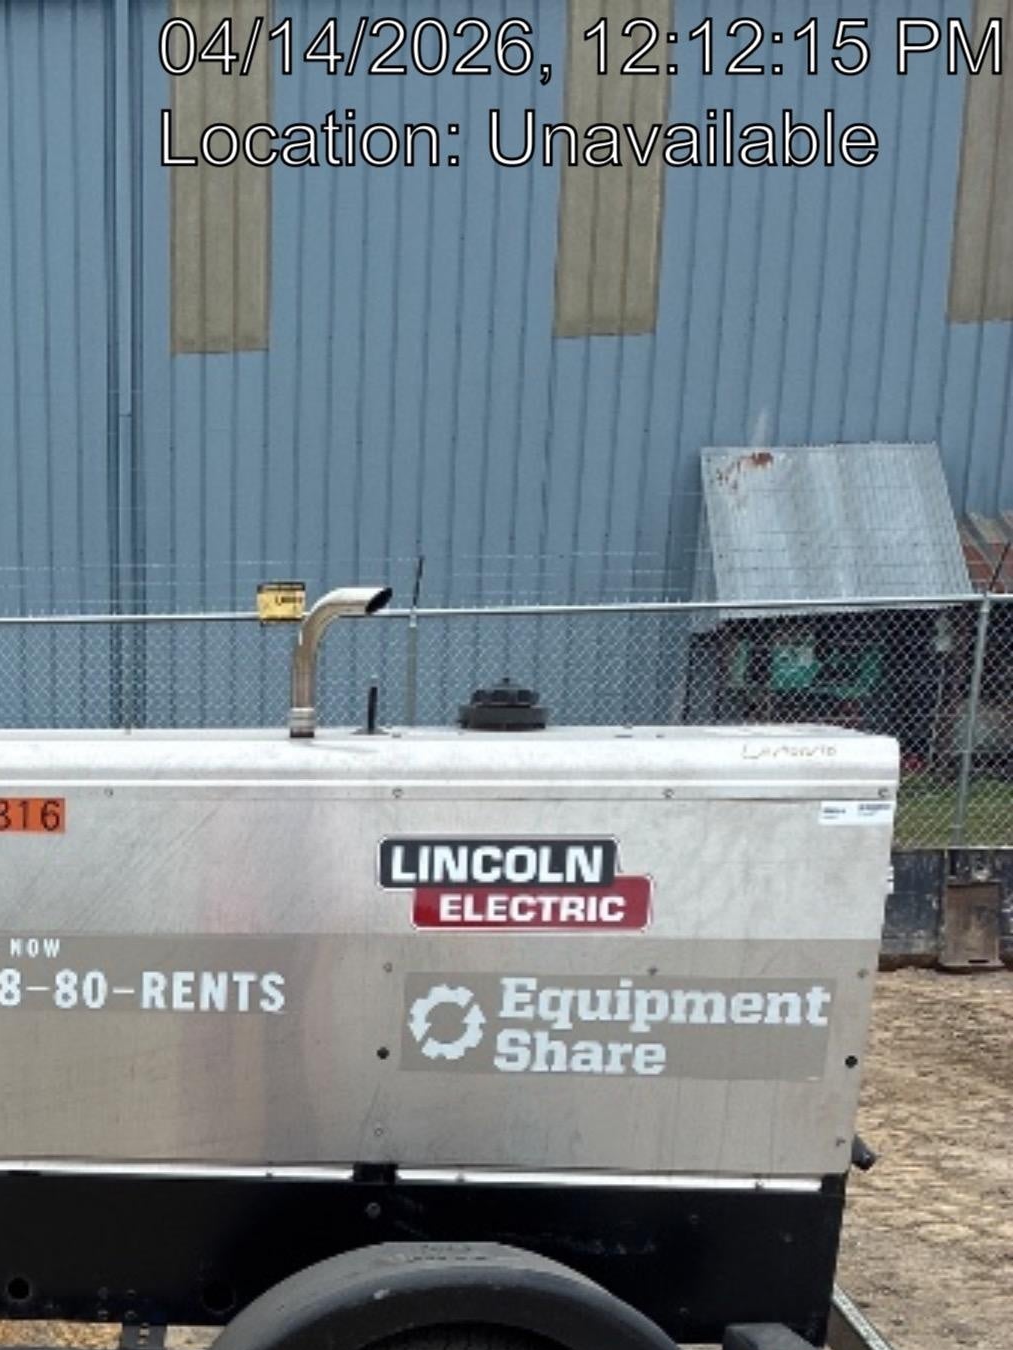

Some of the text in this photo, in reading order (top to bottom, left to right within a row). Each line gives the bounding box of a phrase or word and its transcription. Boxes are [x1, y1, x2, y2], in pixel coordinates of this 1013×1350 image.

[391, 845, 603, 883] LINCOLN
[439, 894, 626, 922] ELECTRIC
[10, 938, 61, 958] NOW
[499, 977, 832, 1031] Equipment
[494, 1028, 667, 1075] Share
